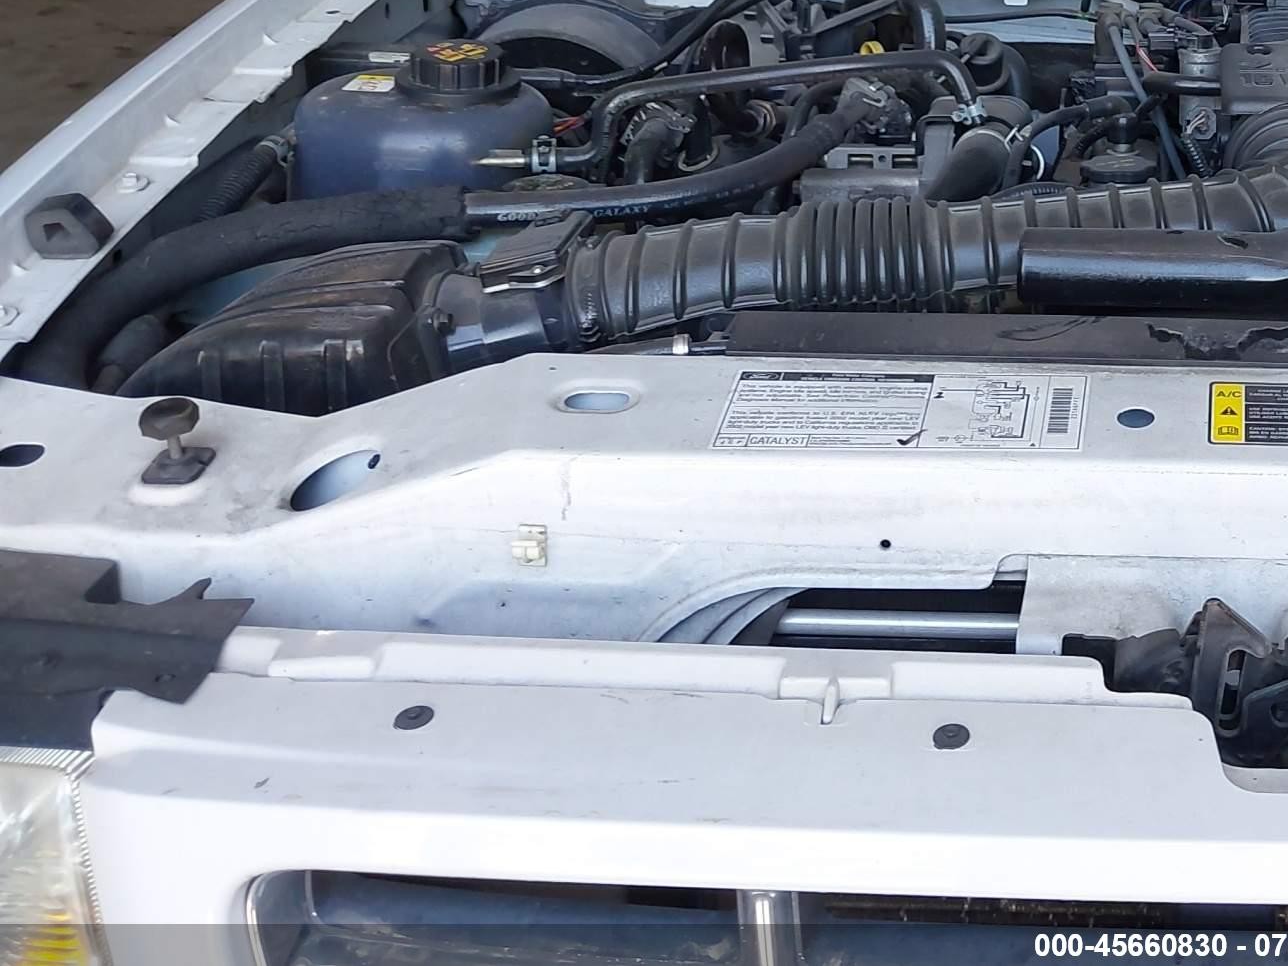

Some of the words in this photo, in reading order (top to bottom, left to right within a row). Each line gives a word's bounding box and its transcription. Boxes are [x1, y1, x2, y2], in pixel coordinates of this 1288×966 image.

[594, 205, 652, 218] GALAXY
[1216, 390, 1242, 398] A/C
[750, 436, 808, 446] CATALYST
